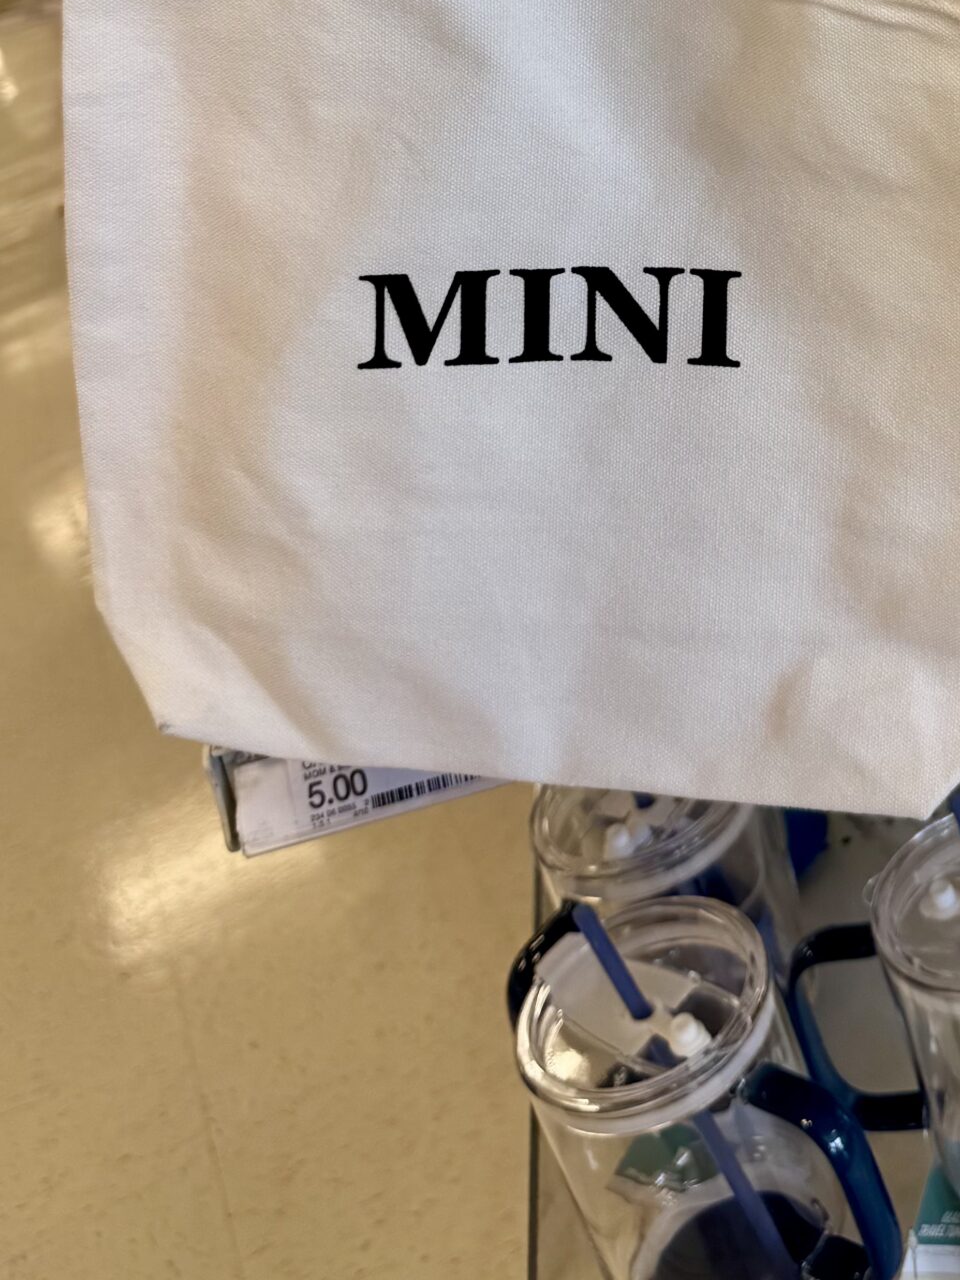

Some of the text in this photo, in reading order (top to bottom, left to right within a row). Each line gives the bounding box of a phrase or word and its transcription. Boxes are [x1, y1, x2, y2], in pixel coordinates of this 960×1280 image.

[358, 266, 742, 369] MINI
[303, 767, 327, 781] MOM
[308, 769, 369, 809] 5.00
